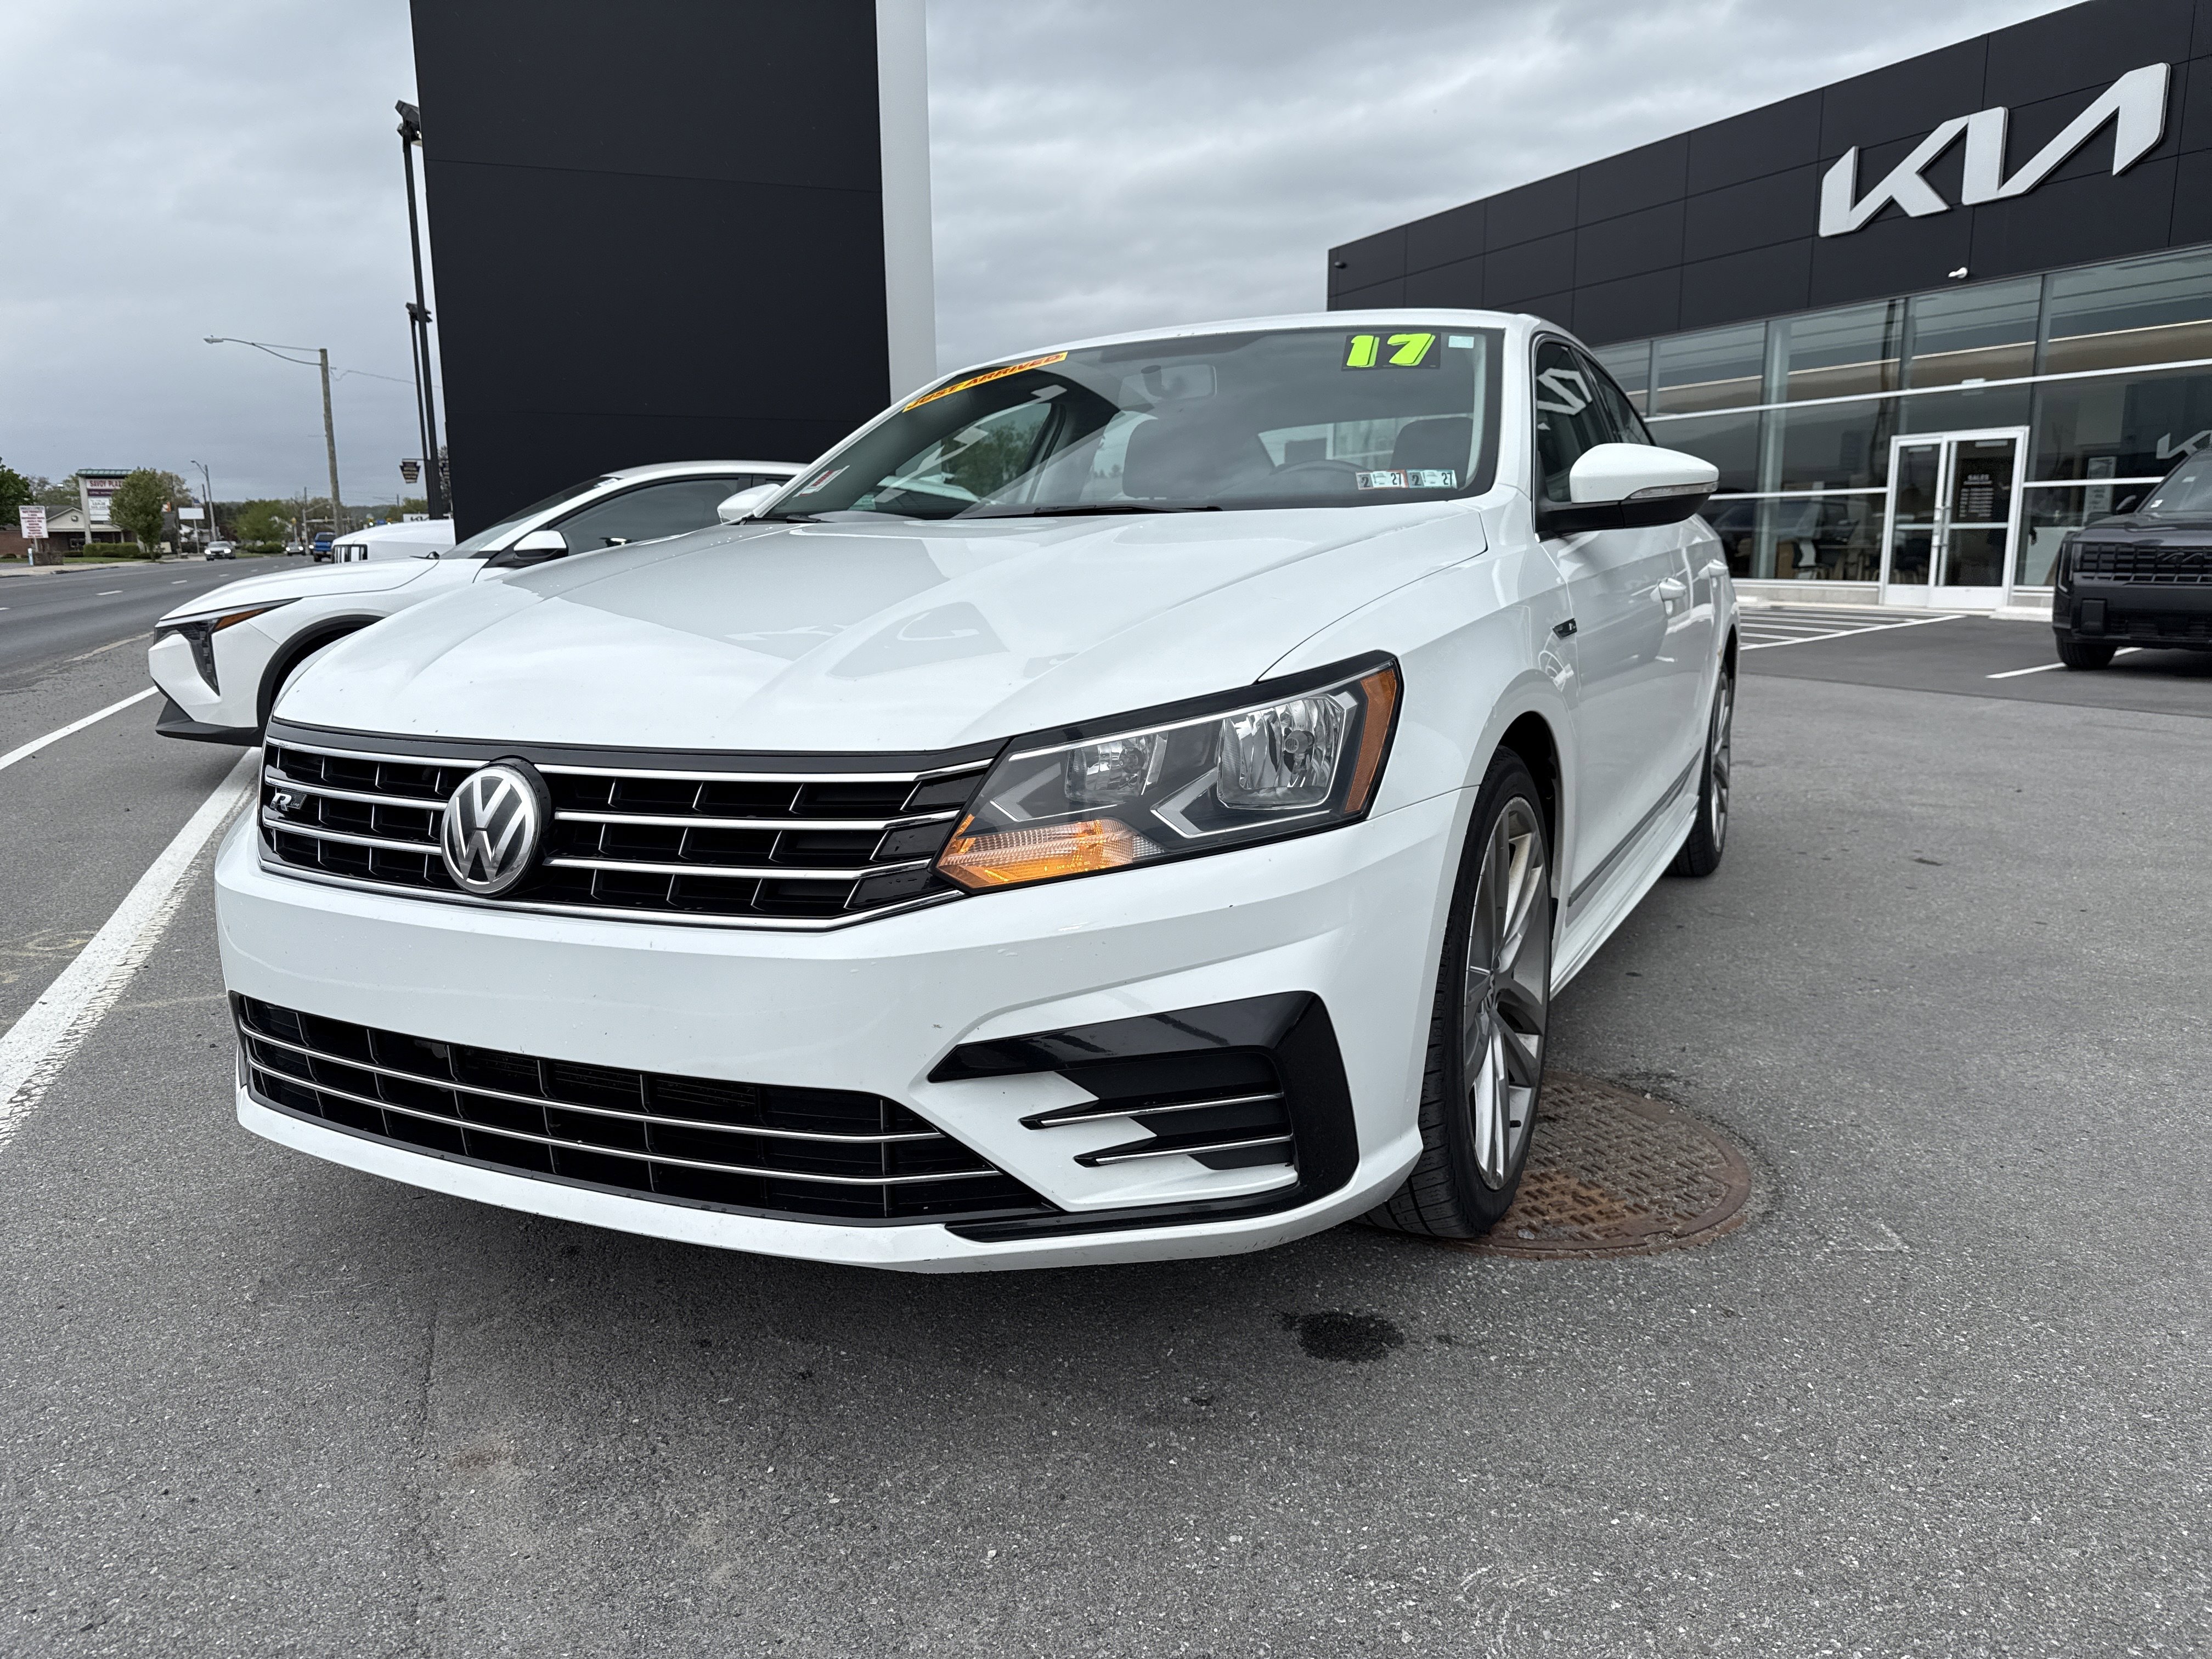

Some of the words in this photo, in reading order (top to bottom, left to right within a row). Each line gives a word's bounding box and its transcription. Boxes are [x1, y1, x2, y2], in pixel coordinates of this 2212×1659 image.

[1819, 61, 2171, 238] KIA
[1346, 333, 1436, 368] 17
[906, 383, 964, 409] JUST
[1361, 476, 1371, 488] 2
[1391, 472, 1401, 486] 27
[1412, 475, 1422, 486] 2
[1441, 472, 1453, 486] 27
[269, 793, 292, 811] R
